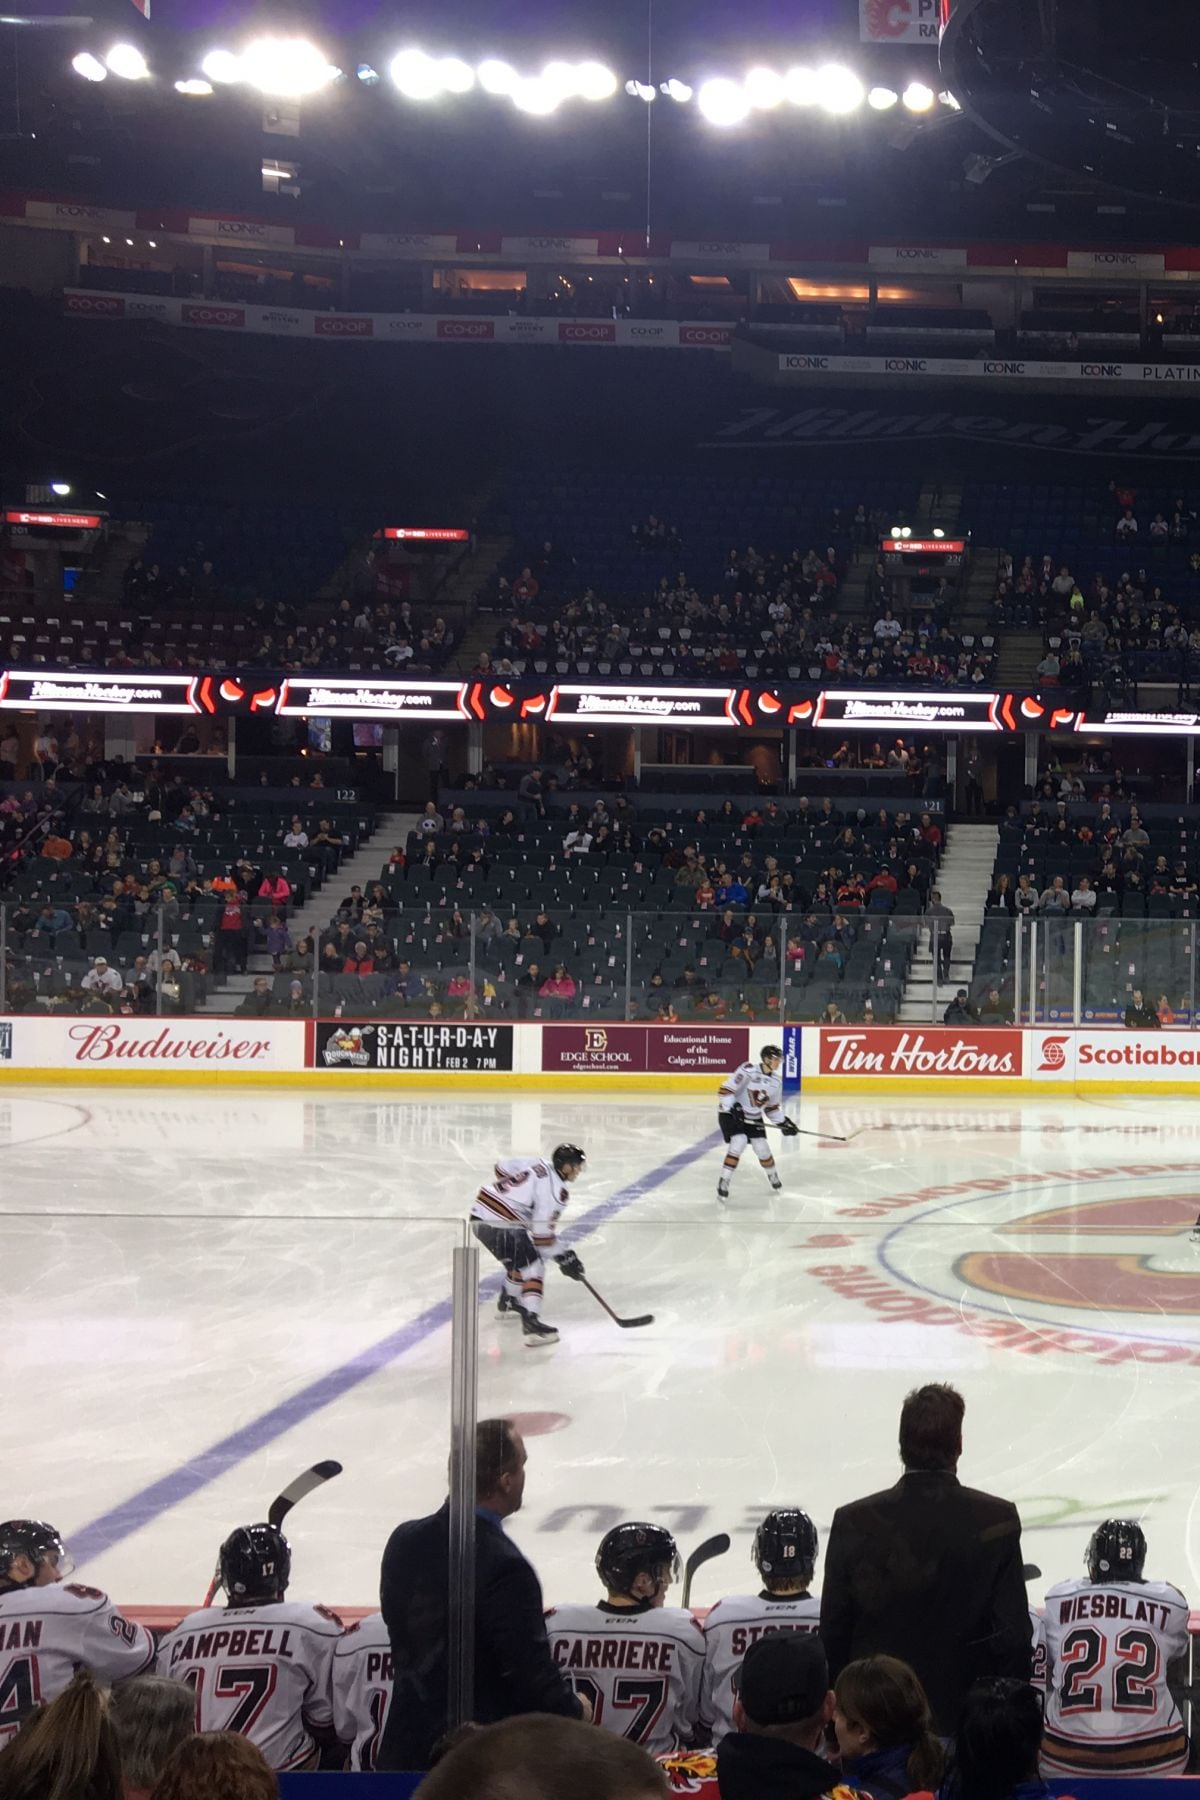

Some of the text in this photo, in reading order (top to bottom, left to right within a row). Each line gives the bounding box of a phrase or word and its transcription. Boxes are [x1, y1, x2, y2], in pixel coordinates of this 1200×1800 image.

[218, 222, 265, 234] ICONIC
[896, 248, 938, 259] ICONIC
[1094, 253, 1136, 264] ICONIC
[189, 309, 238, 320] CO-OP
[322, 320, 368, 331] CO-OP
[444, 324, 487, 335] CO-OP
[566, 327, 608, 337] CO-OP
[685, 330, 729, 341] CO-OP
[786, 356, 829, 368] ICONIC
[885, 359, 928, 371] ICONIC
[983, 362, 1025, 374] ICONIC
[1080, 364, 1121, 376] ICONIC
[31, 681, 161, 703] HitmenHockey.com
[307, 688, 431, 708] HitmenHockey.com
[577, 695, 700, 715] HitmenHockey.com
[843, 700, 965, 720] HitmenHockey.com
[336, 789, 356, 800] 122
[69, 1024, 271, 1061] Budweiser
[377, 1025, 498, 1048] S-A-T-U-R-D-A-Y
[664, 1035, 732, 1044] Educational Home
[687, 1046, 708, 1054] of the
[827, 1033, 1013, 1072] Tim Hortons
[377, 1047, 441, 1068] NIGHT!
[446, 1057, 461, 1068] FEB
[462, 1058, 468, 1068] 2
[484, 1058, 496, 1069] PM
[560, 1052, 632, 1062] EDGE SCHOOL
[668, 1055, 726, 1066] Calgary Hitmen
[784, 1544, 796, 1558] 18
[1120, 1546, 1132, 1559] 22
[262, 1562, 274, 1576] 17
[1059, 1594, 1171, 1631] WIESBLATT
[170, 1629, 293, 1667] CAMPBELL
[553, 1639, 676, 1672] CARRIERE
[1059, 1624, 1160, 1717] 22
[182, 1662, 278, 1737] 17
